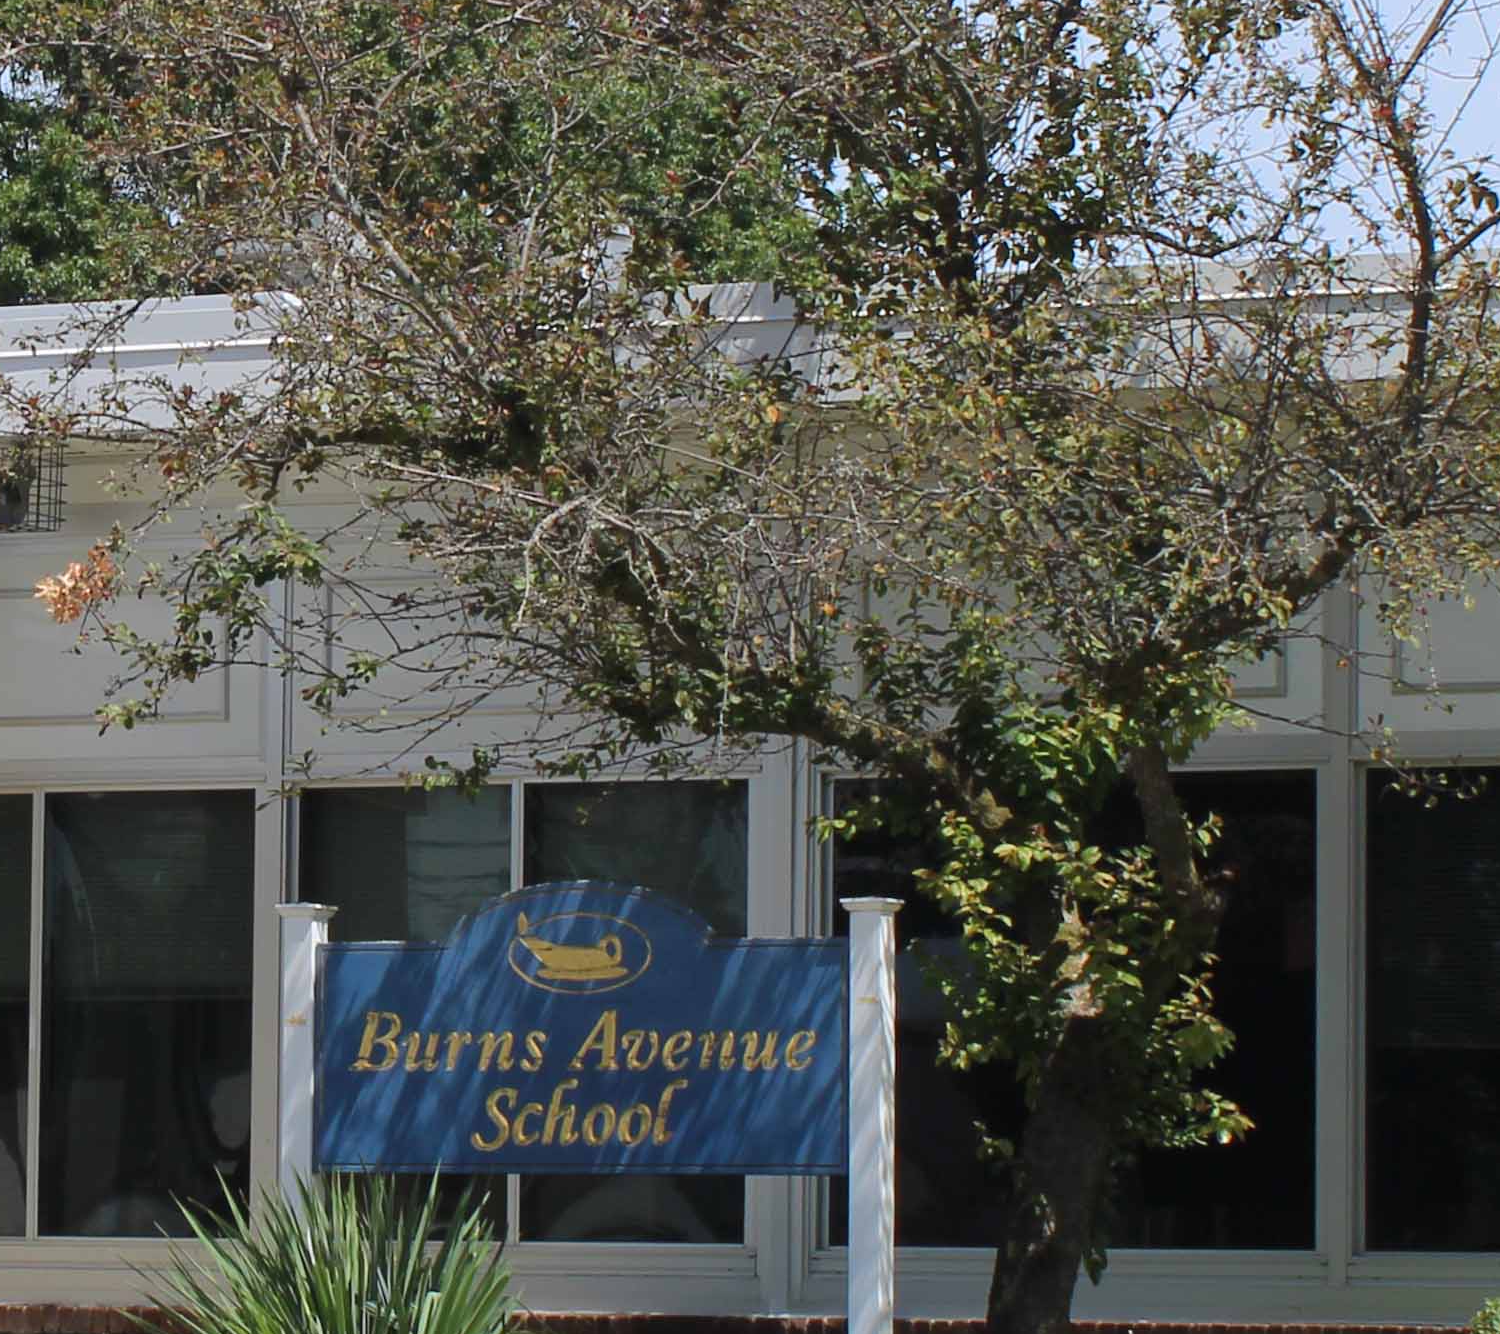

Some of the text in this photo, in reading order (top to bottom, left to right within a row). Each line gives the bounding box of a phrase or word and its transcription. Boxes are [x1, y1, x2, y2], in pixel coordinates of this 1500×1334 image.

[350, 1009, 817, 1072] Burns Avenue
[470, 1078, 688, 1151] School
